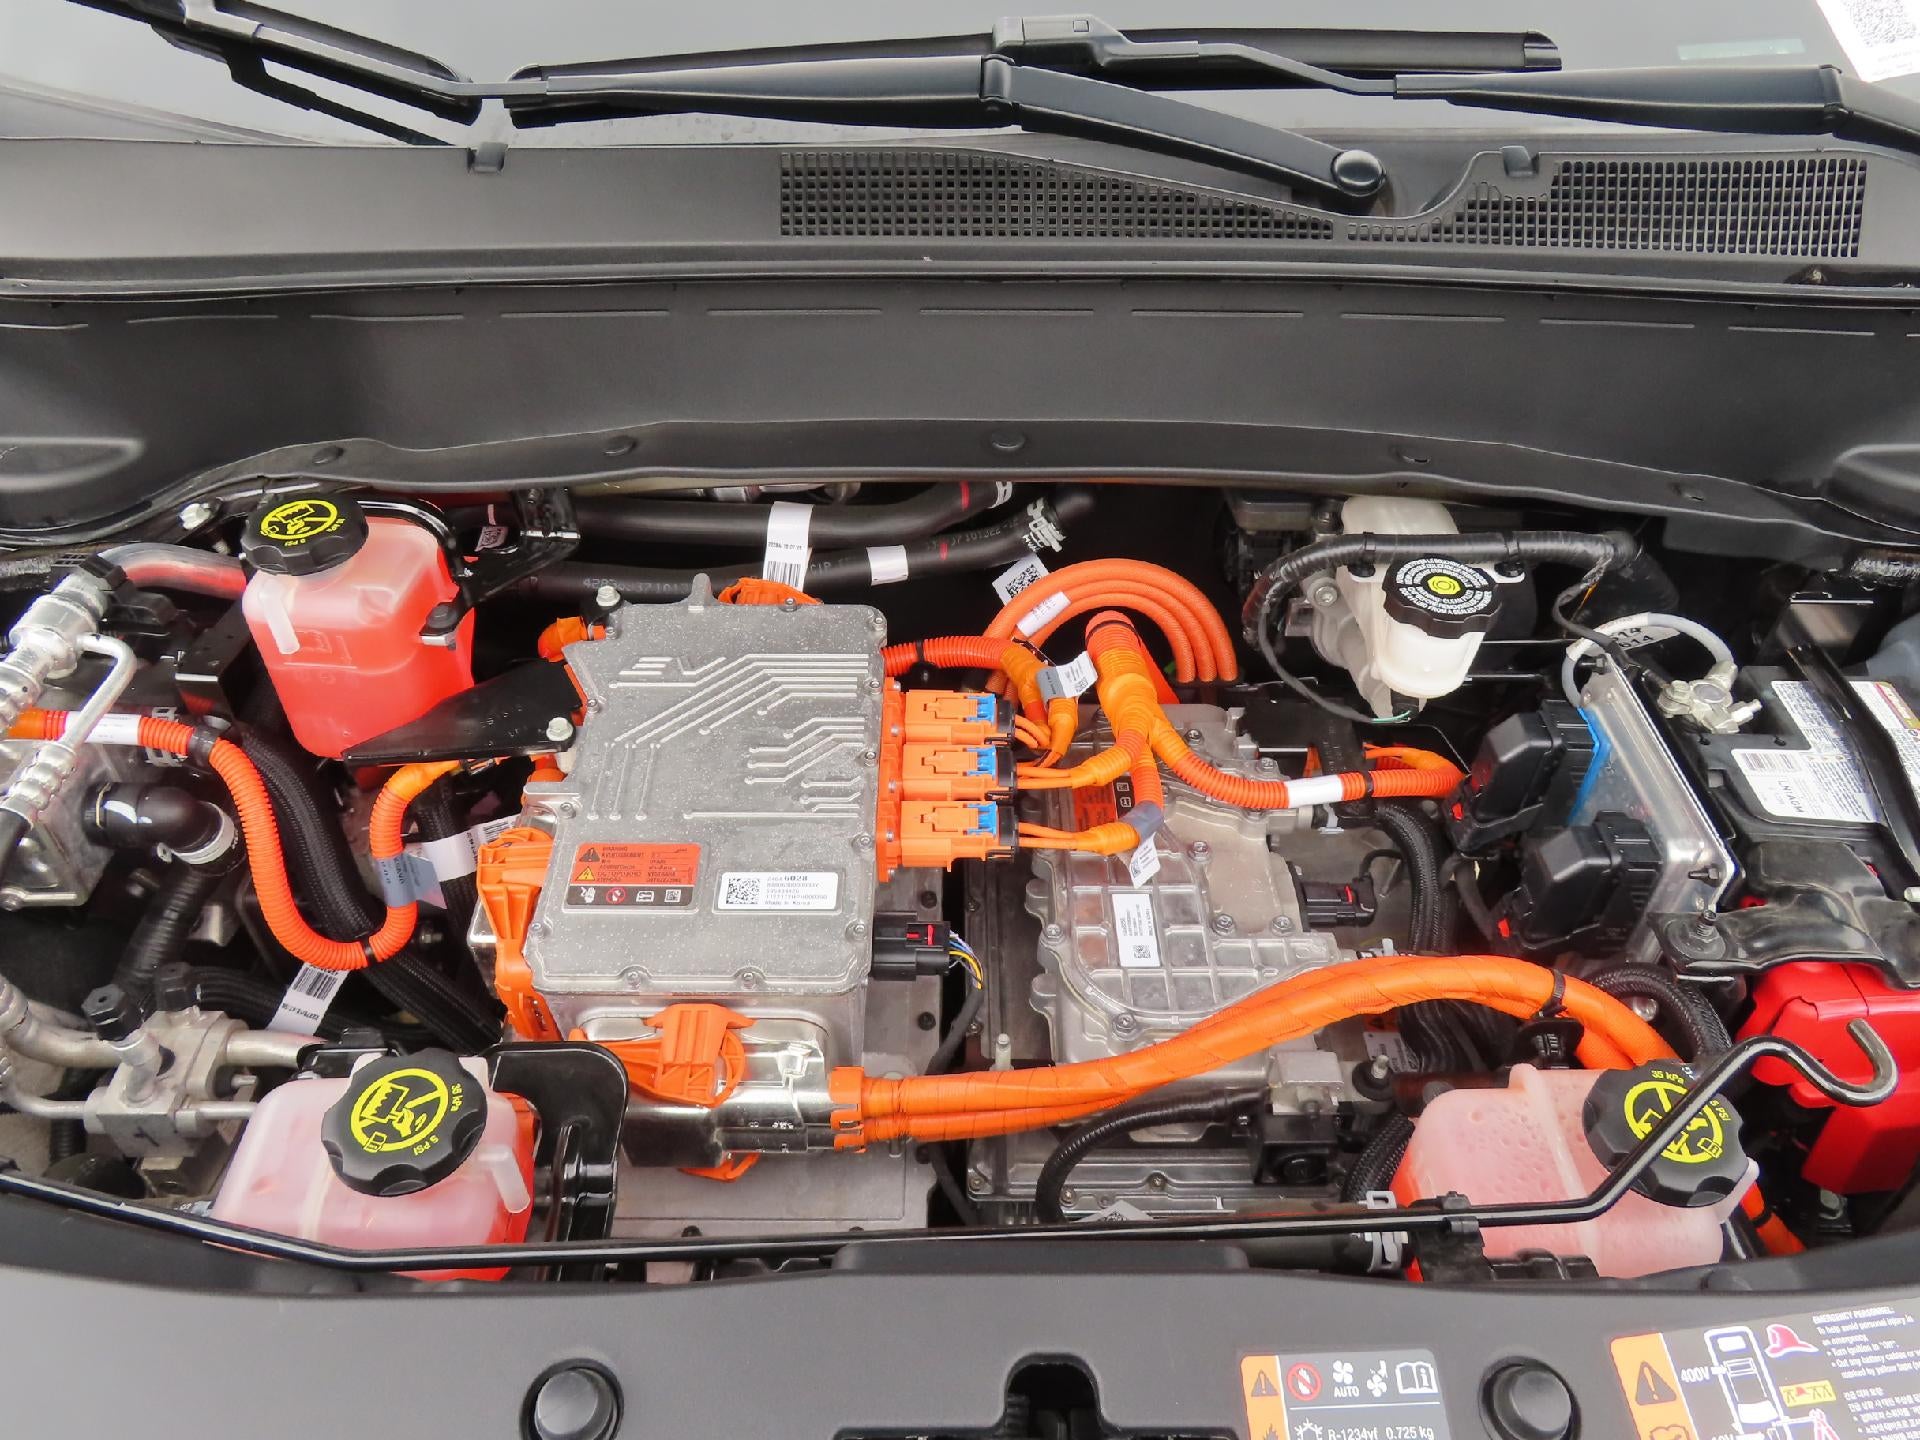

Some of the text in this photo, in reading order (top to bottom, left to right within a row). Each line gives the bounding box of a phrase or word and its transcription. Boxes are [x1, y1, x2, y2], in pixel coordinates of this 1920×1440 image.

[1651, 1070, 1663, 1079] 35
[1665, 1072, 1684, 1084] kPa
[451, 1083, 463, 1111] 35 kPa
[1716, 1107, 1731, 1121] PSI
[413, 1135, 439, 1155] 5 PSI
[1680, 1366, 1710, 1383] 400V
[1333, 1385, 1360, 1398] AUTO
[1386, 1426, 1417, 1440] 0.725
[1418, 1426, 1435, 1440] kg
